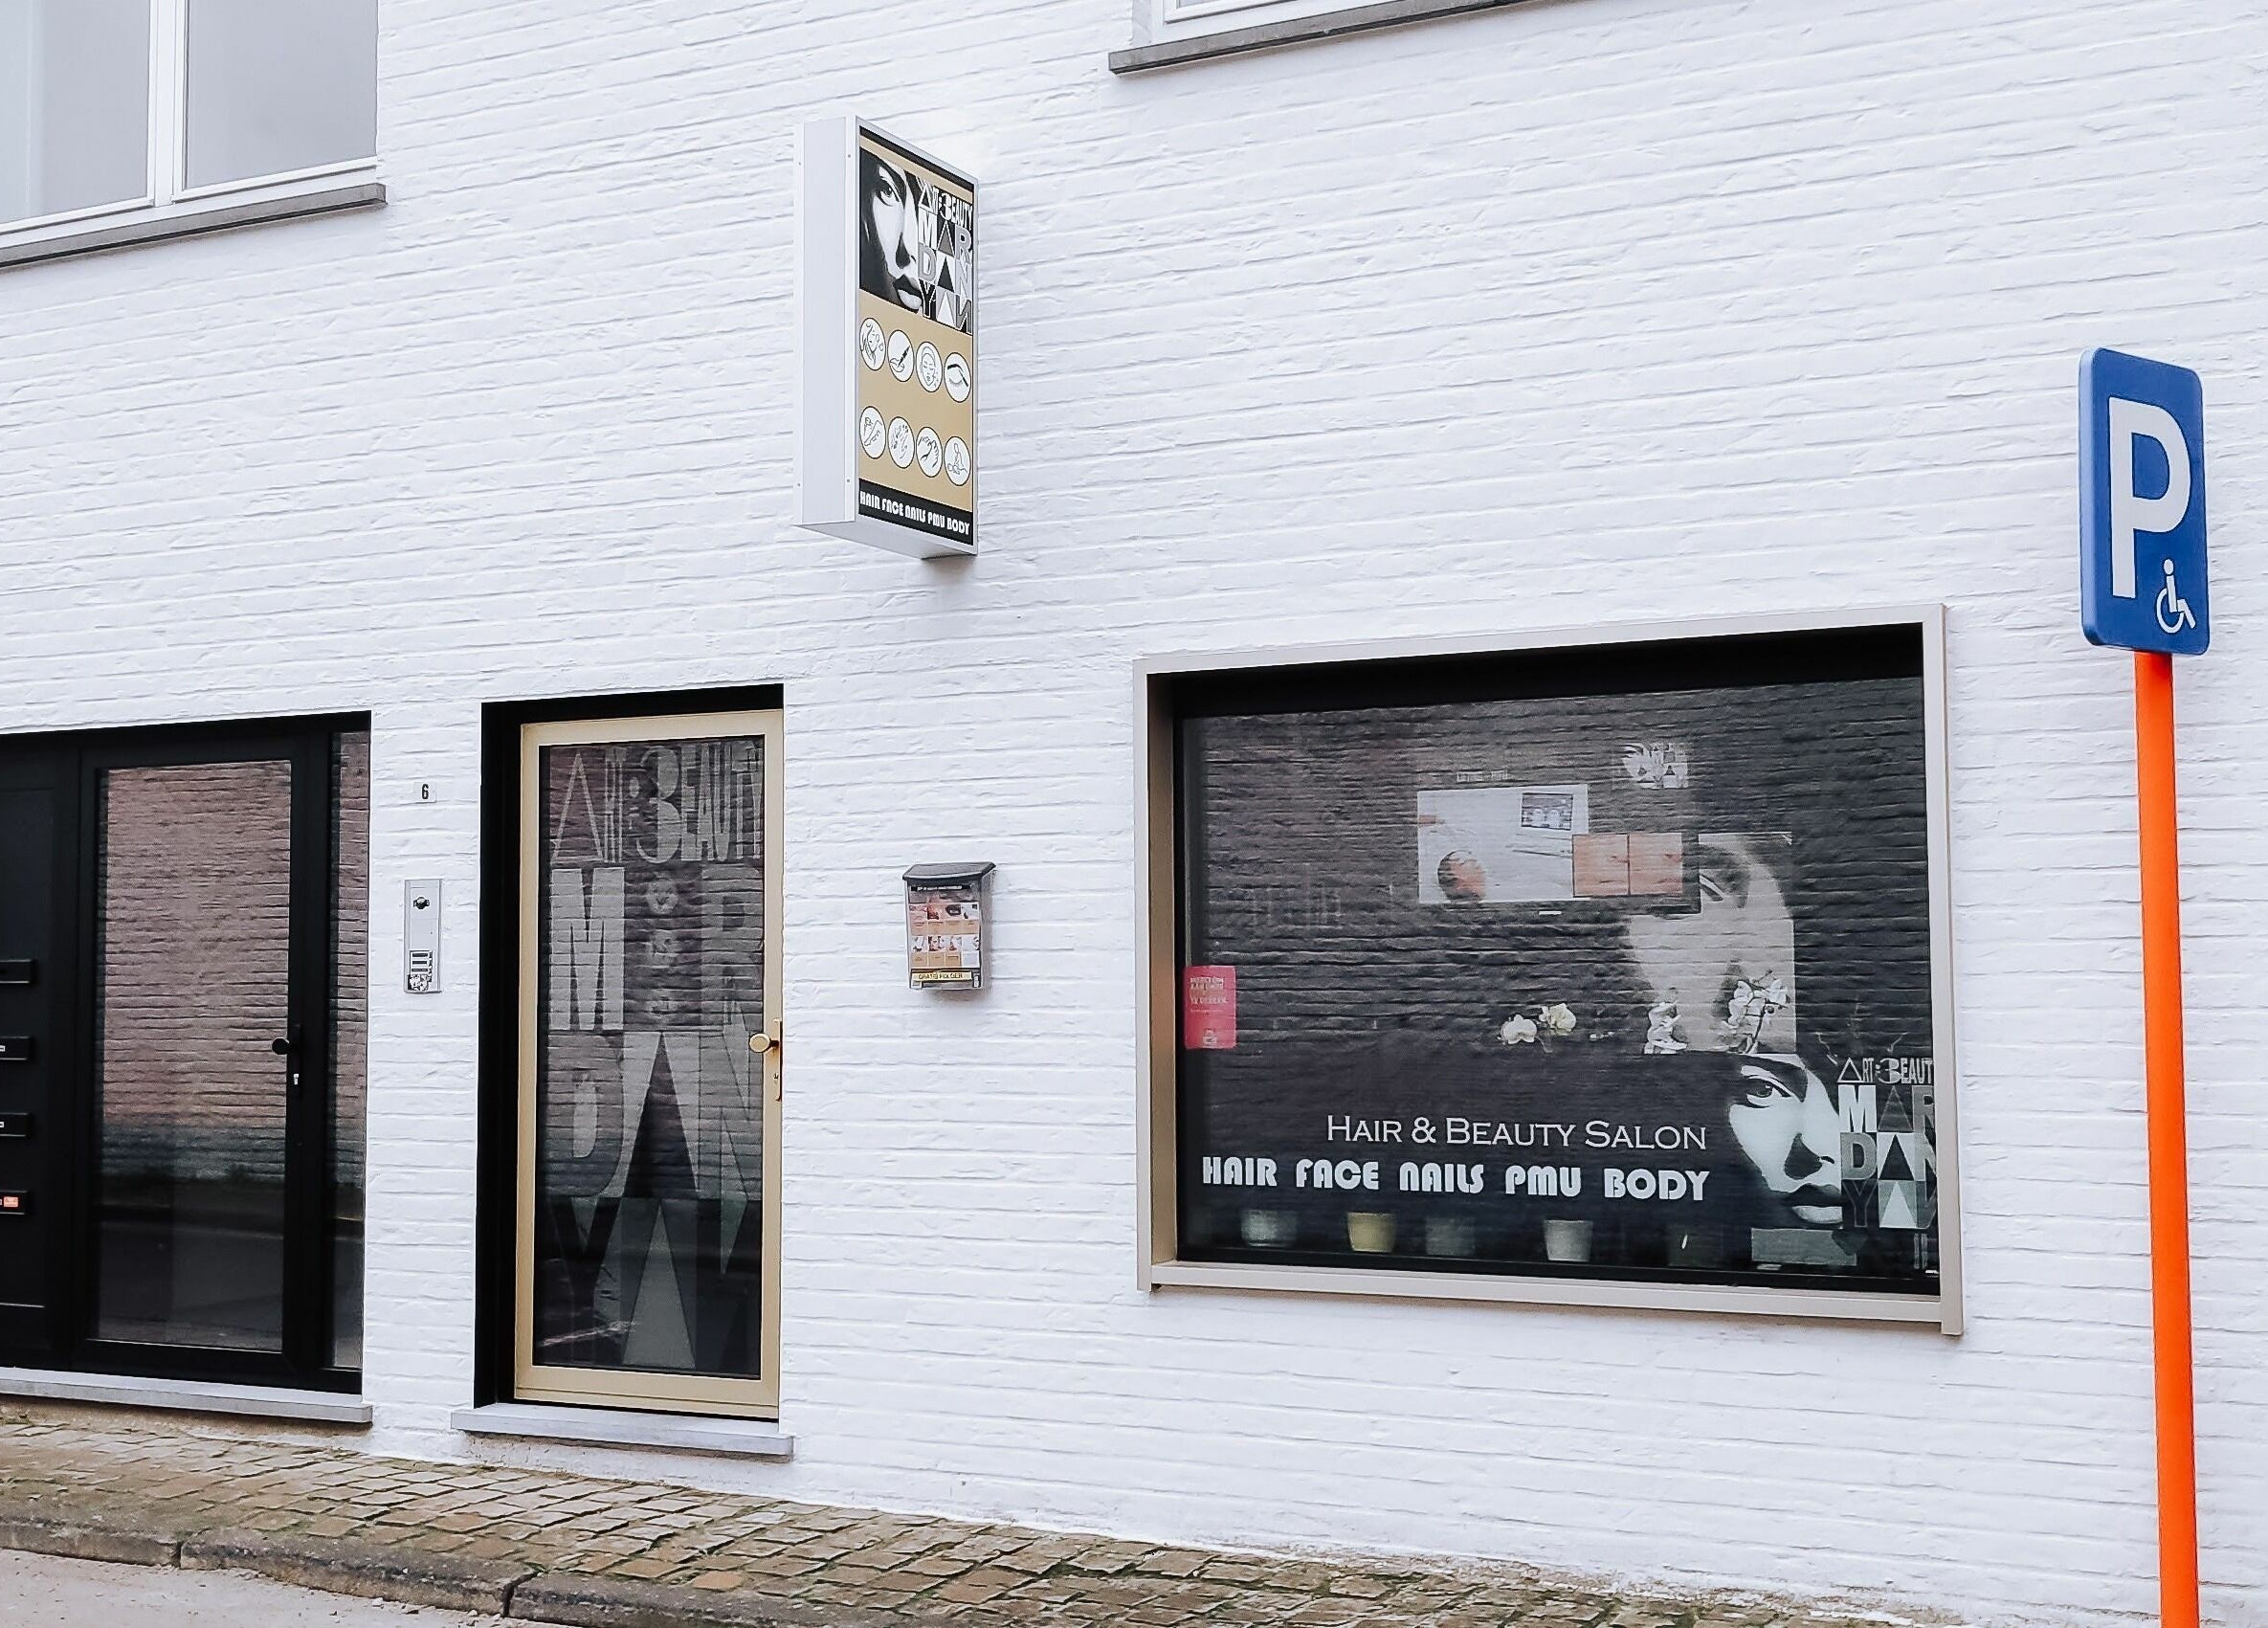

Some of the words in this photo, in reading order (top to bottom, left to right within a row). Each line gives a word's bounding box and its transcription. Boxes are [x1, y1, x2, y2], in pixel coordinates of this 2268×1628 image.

[859, 490, 880, 510] HAIR
[881, 498, 904, 517] FACE
[904, 504, 926, 524] NAILS
[927, 511, 945, 528] PMU
[946, 517, 970, 536] BODY
[2108, 396, 2191, 599] P
[421, 783, 430, 800] 6
[1837, 1057, 1875, 1083] ART
[1878, 1057, 1934, 1084] BEAUT
[1412, 1117, 1436, 1143] &
[1203, 1157, 1277, 1186] HAIR
[1297, 1159, 1379, 1190] FACE
[1400, 1162, 1483, 1193] NAILS
[1505, 1166, 1581, 1196] PMU
[1604, 1169, 1709, 1200] BODY
